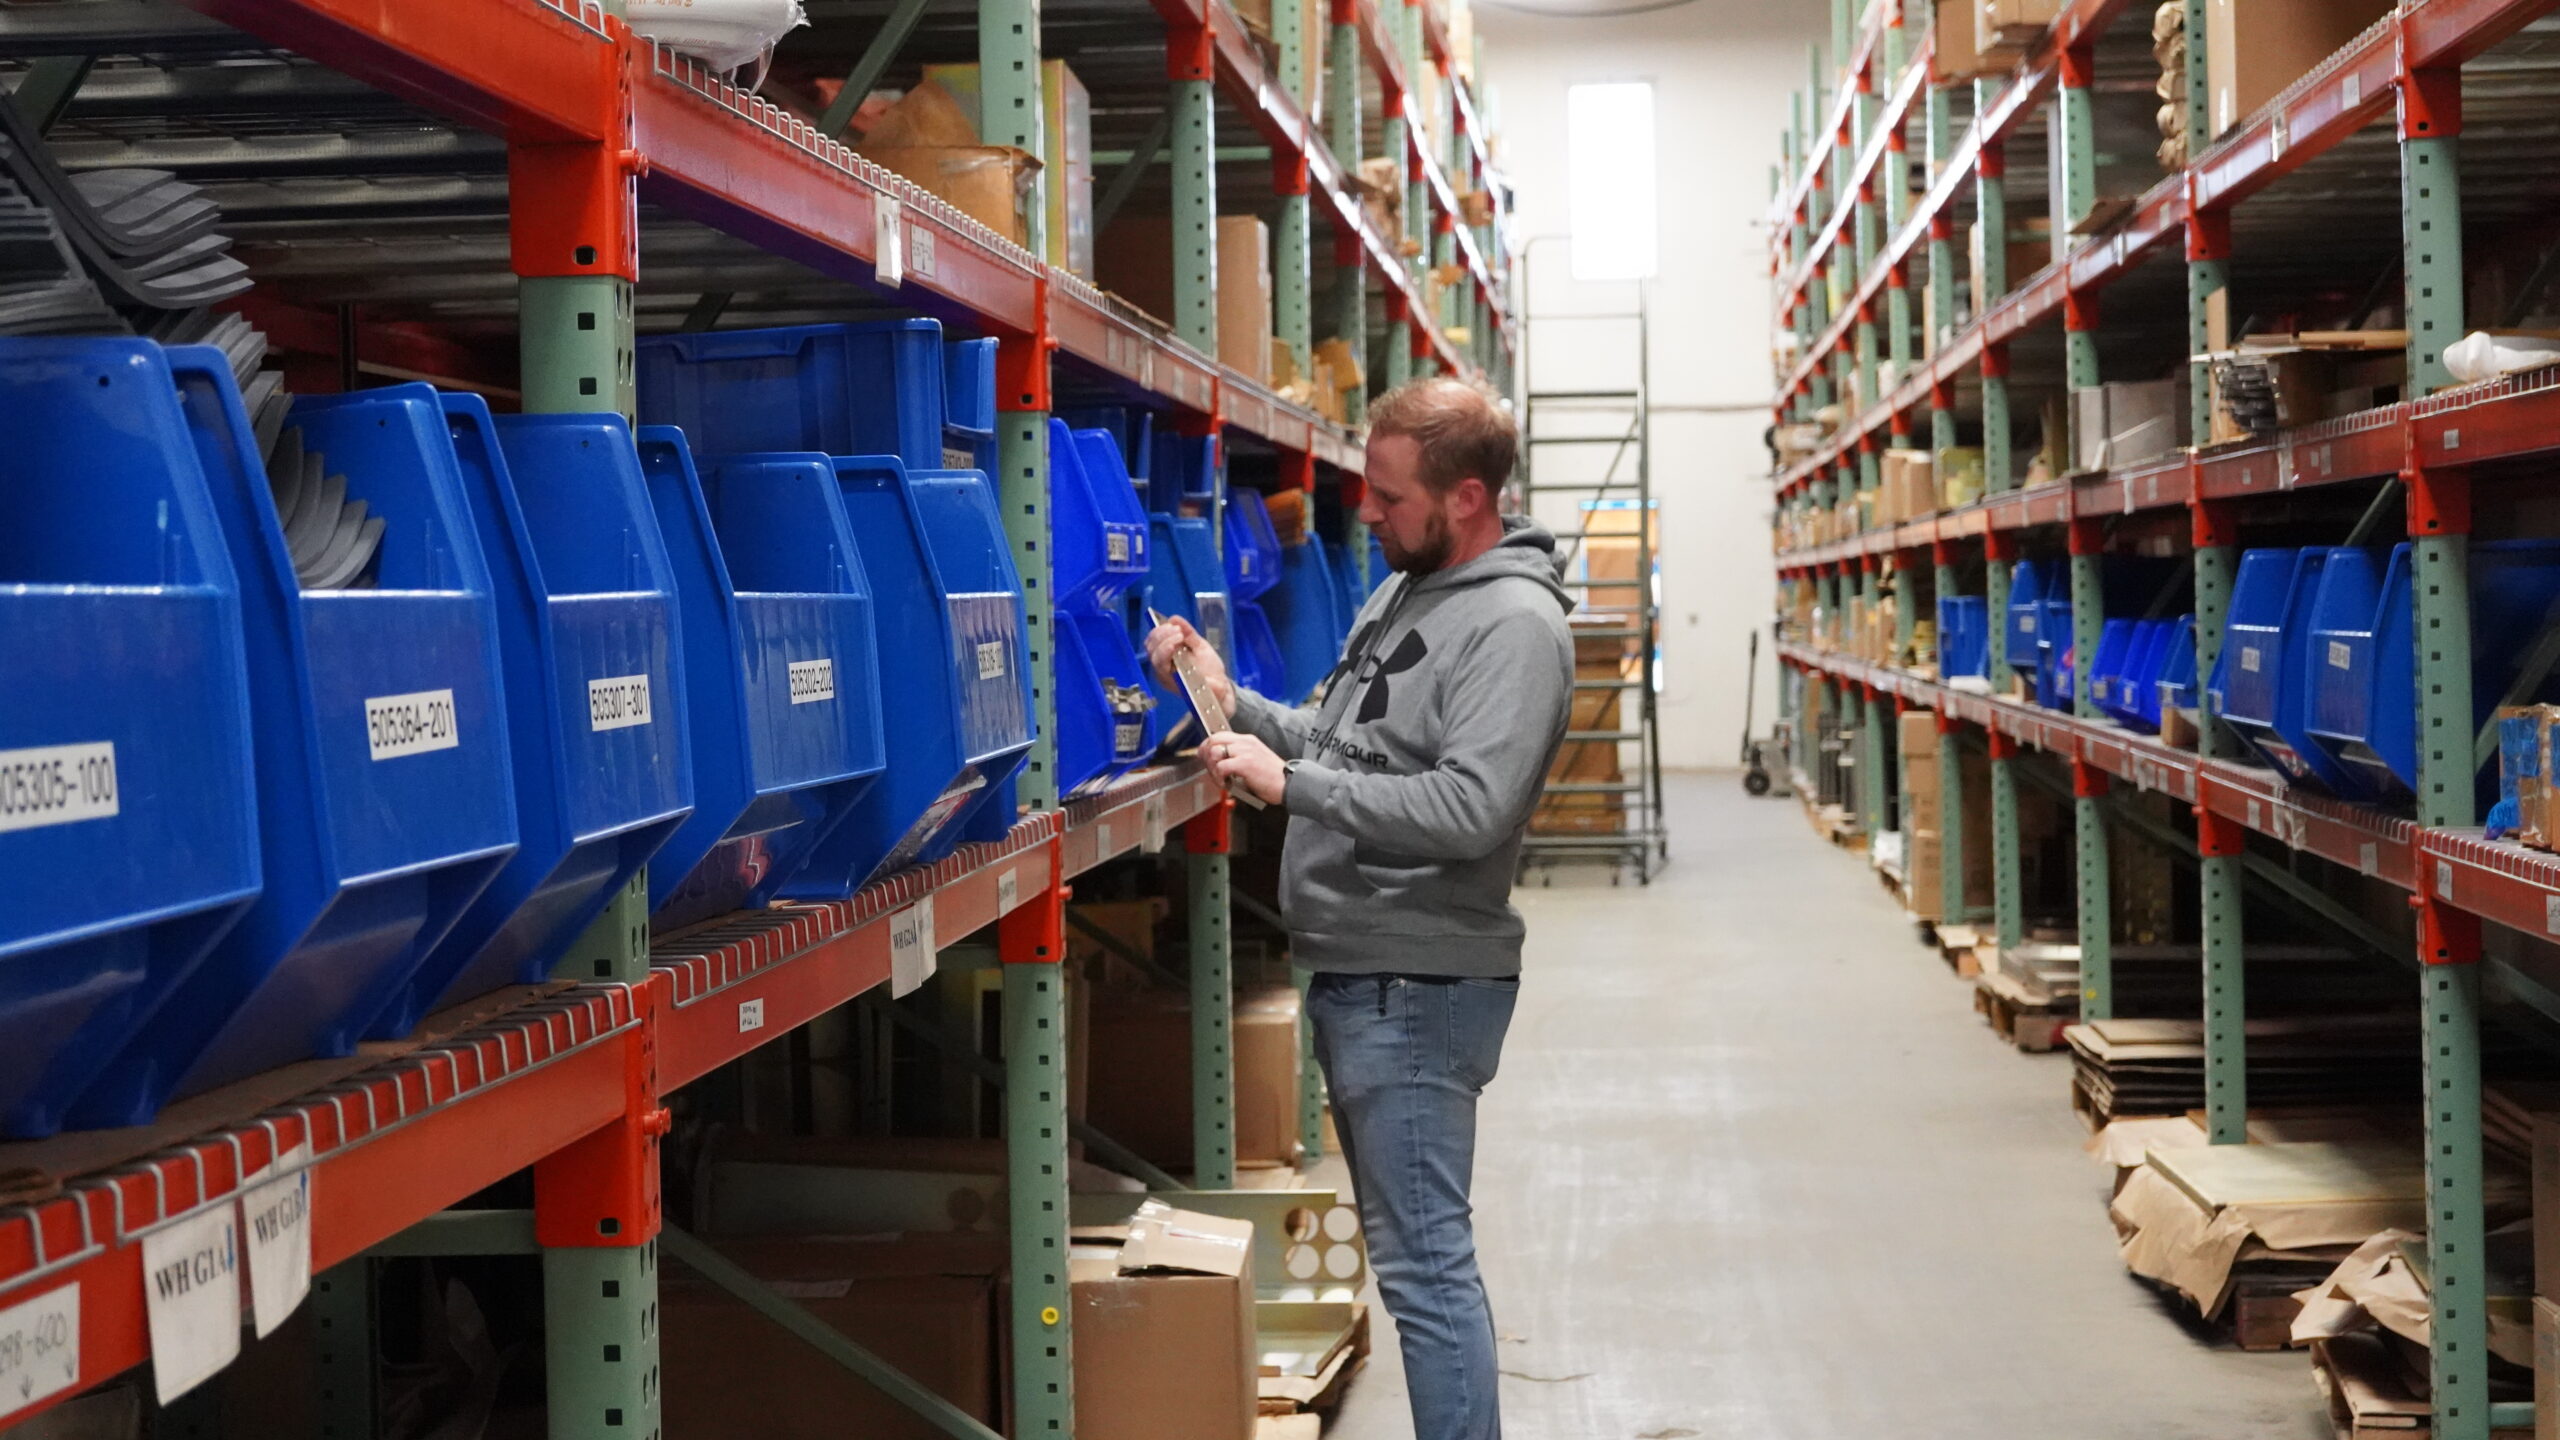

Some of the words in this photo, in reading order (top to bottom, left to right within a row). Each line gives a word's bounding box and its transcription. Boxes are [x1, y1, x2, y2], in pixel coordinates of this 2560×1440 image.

[592, 683, 649, 722] 505307-301
[791, 666, 833, 697] 505302-202
[370, 700, 454, 748] 505364-201
[0, 756, 113, 815] 05305-100
[255, 1204, 280, 1249] WH
[155, 1258, 191, 1302] WH
[194, 1246, 228, 1287] G1A
